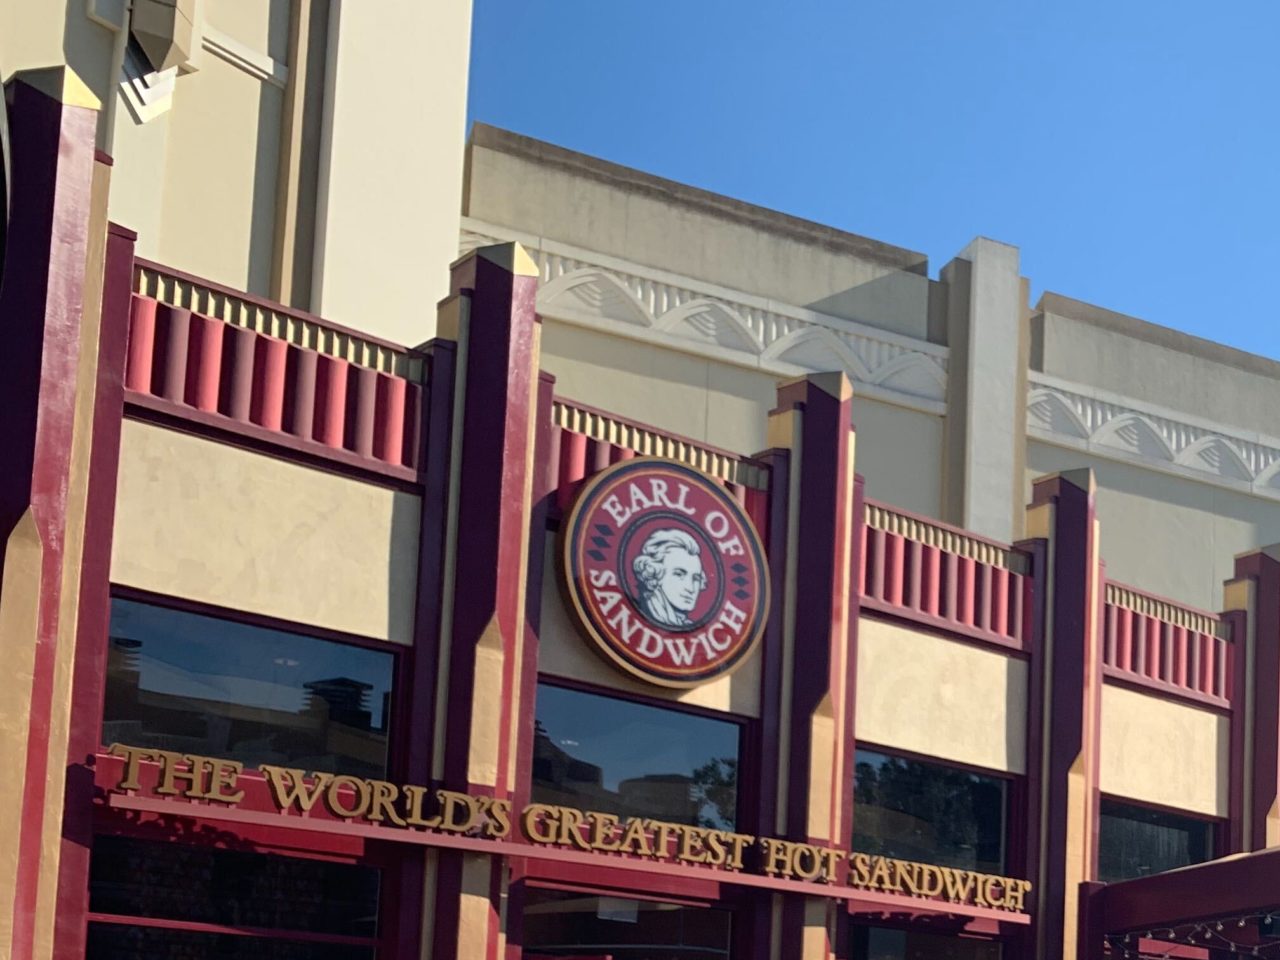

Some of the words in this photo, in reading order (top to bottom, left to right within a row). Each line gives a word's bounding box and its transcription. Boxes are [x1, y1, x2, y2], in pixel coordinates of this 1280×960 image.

[602, 478, 696, 528] EARL
[705, 511, 744, 557] OF
[589, 568, 747, 666] SANDWICH
[107, 743, 245, 803] THE
[258, 763, 511, 839] WORLD'S
[521, 803, 754, 870] GREATEST
[761, 838, 847, 883] HOT
[850, 852, 1027, 912] SANDWICH
